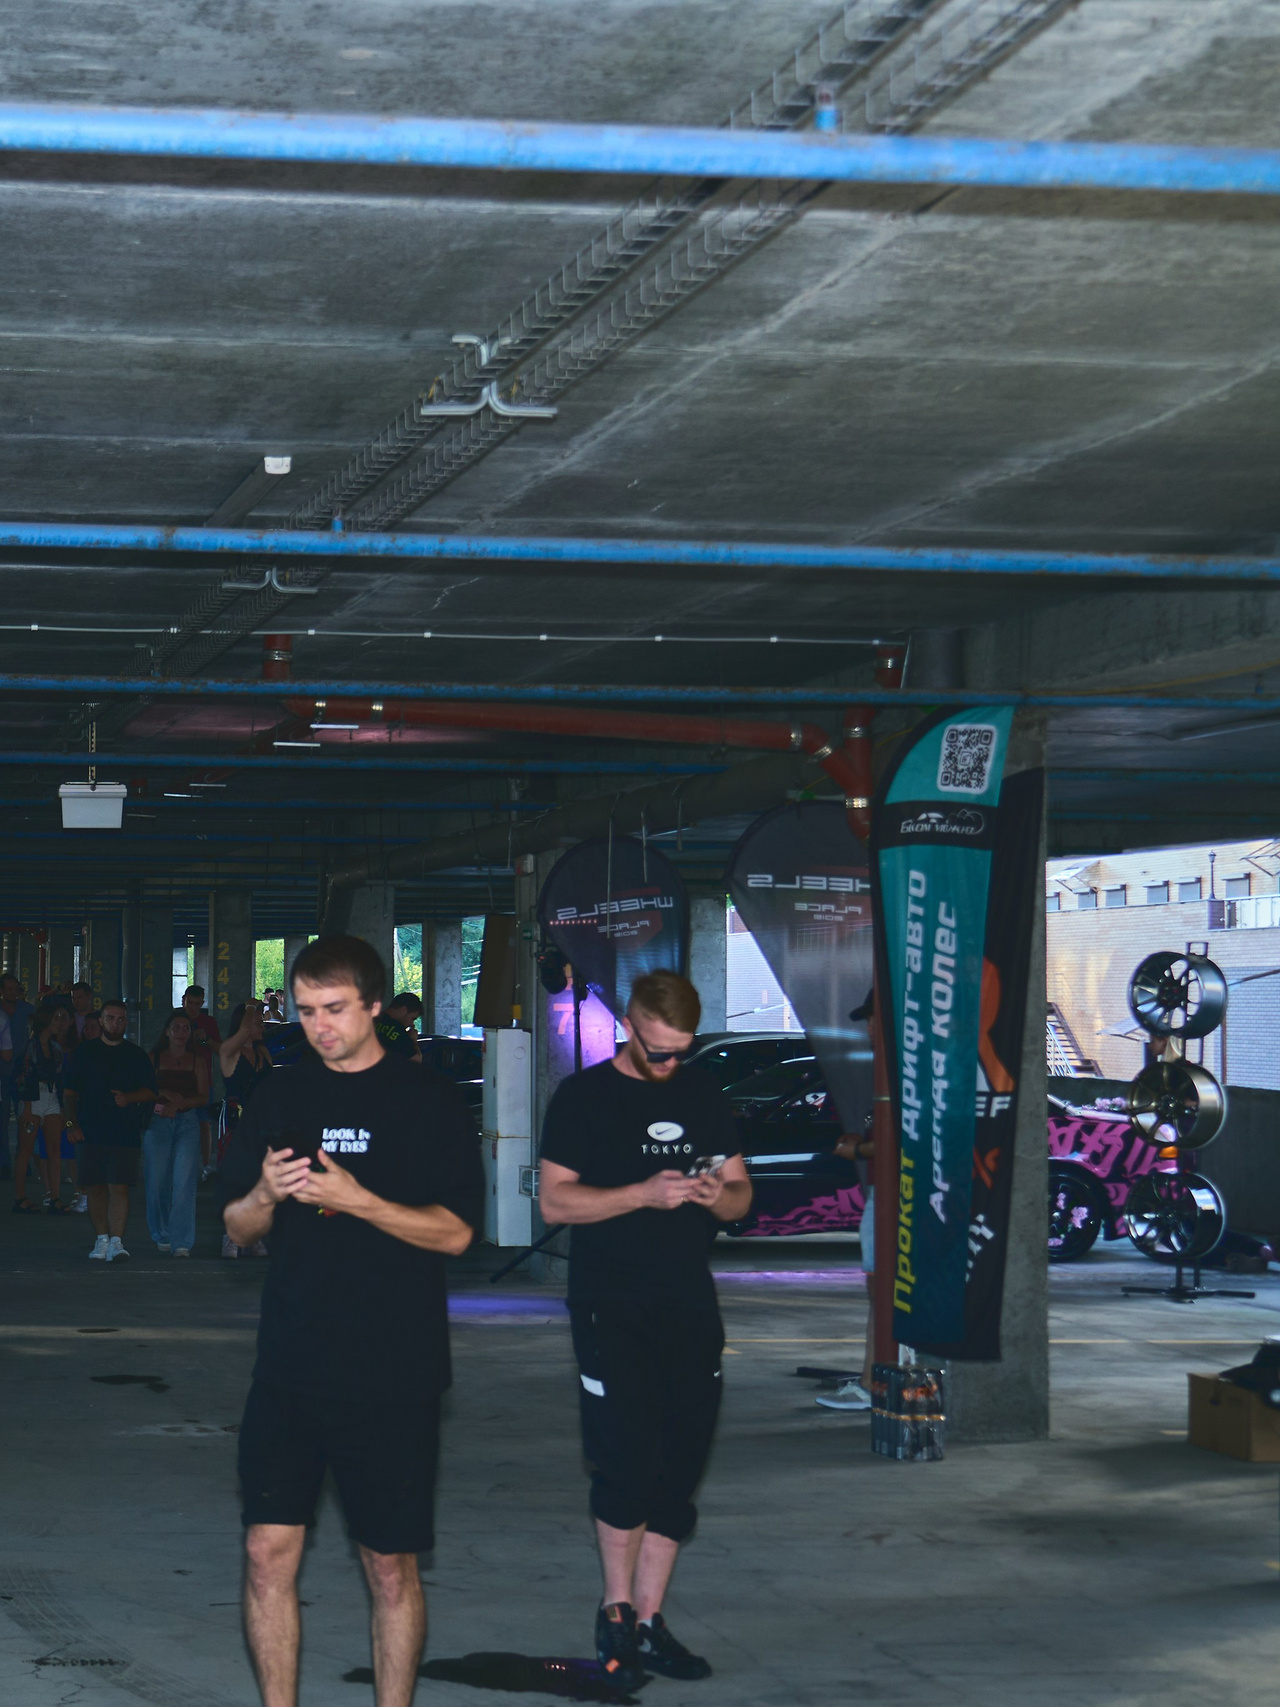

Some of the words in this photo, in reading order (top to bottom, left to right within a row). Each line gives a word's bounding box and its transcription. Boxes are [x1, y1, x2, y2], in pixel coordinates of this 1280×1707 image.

[217, 942, 230, 1010] 243
[931, 900, 959, 1039] колес
[322, 1128, 356, 1140] LOOK
[339, 1140, 368, 1153] EYES
[641, 1143, 693, 1155] TOKYO
[893, 1147, 917, 1314] Прокат
